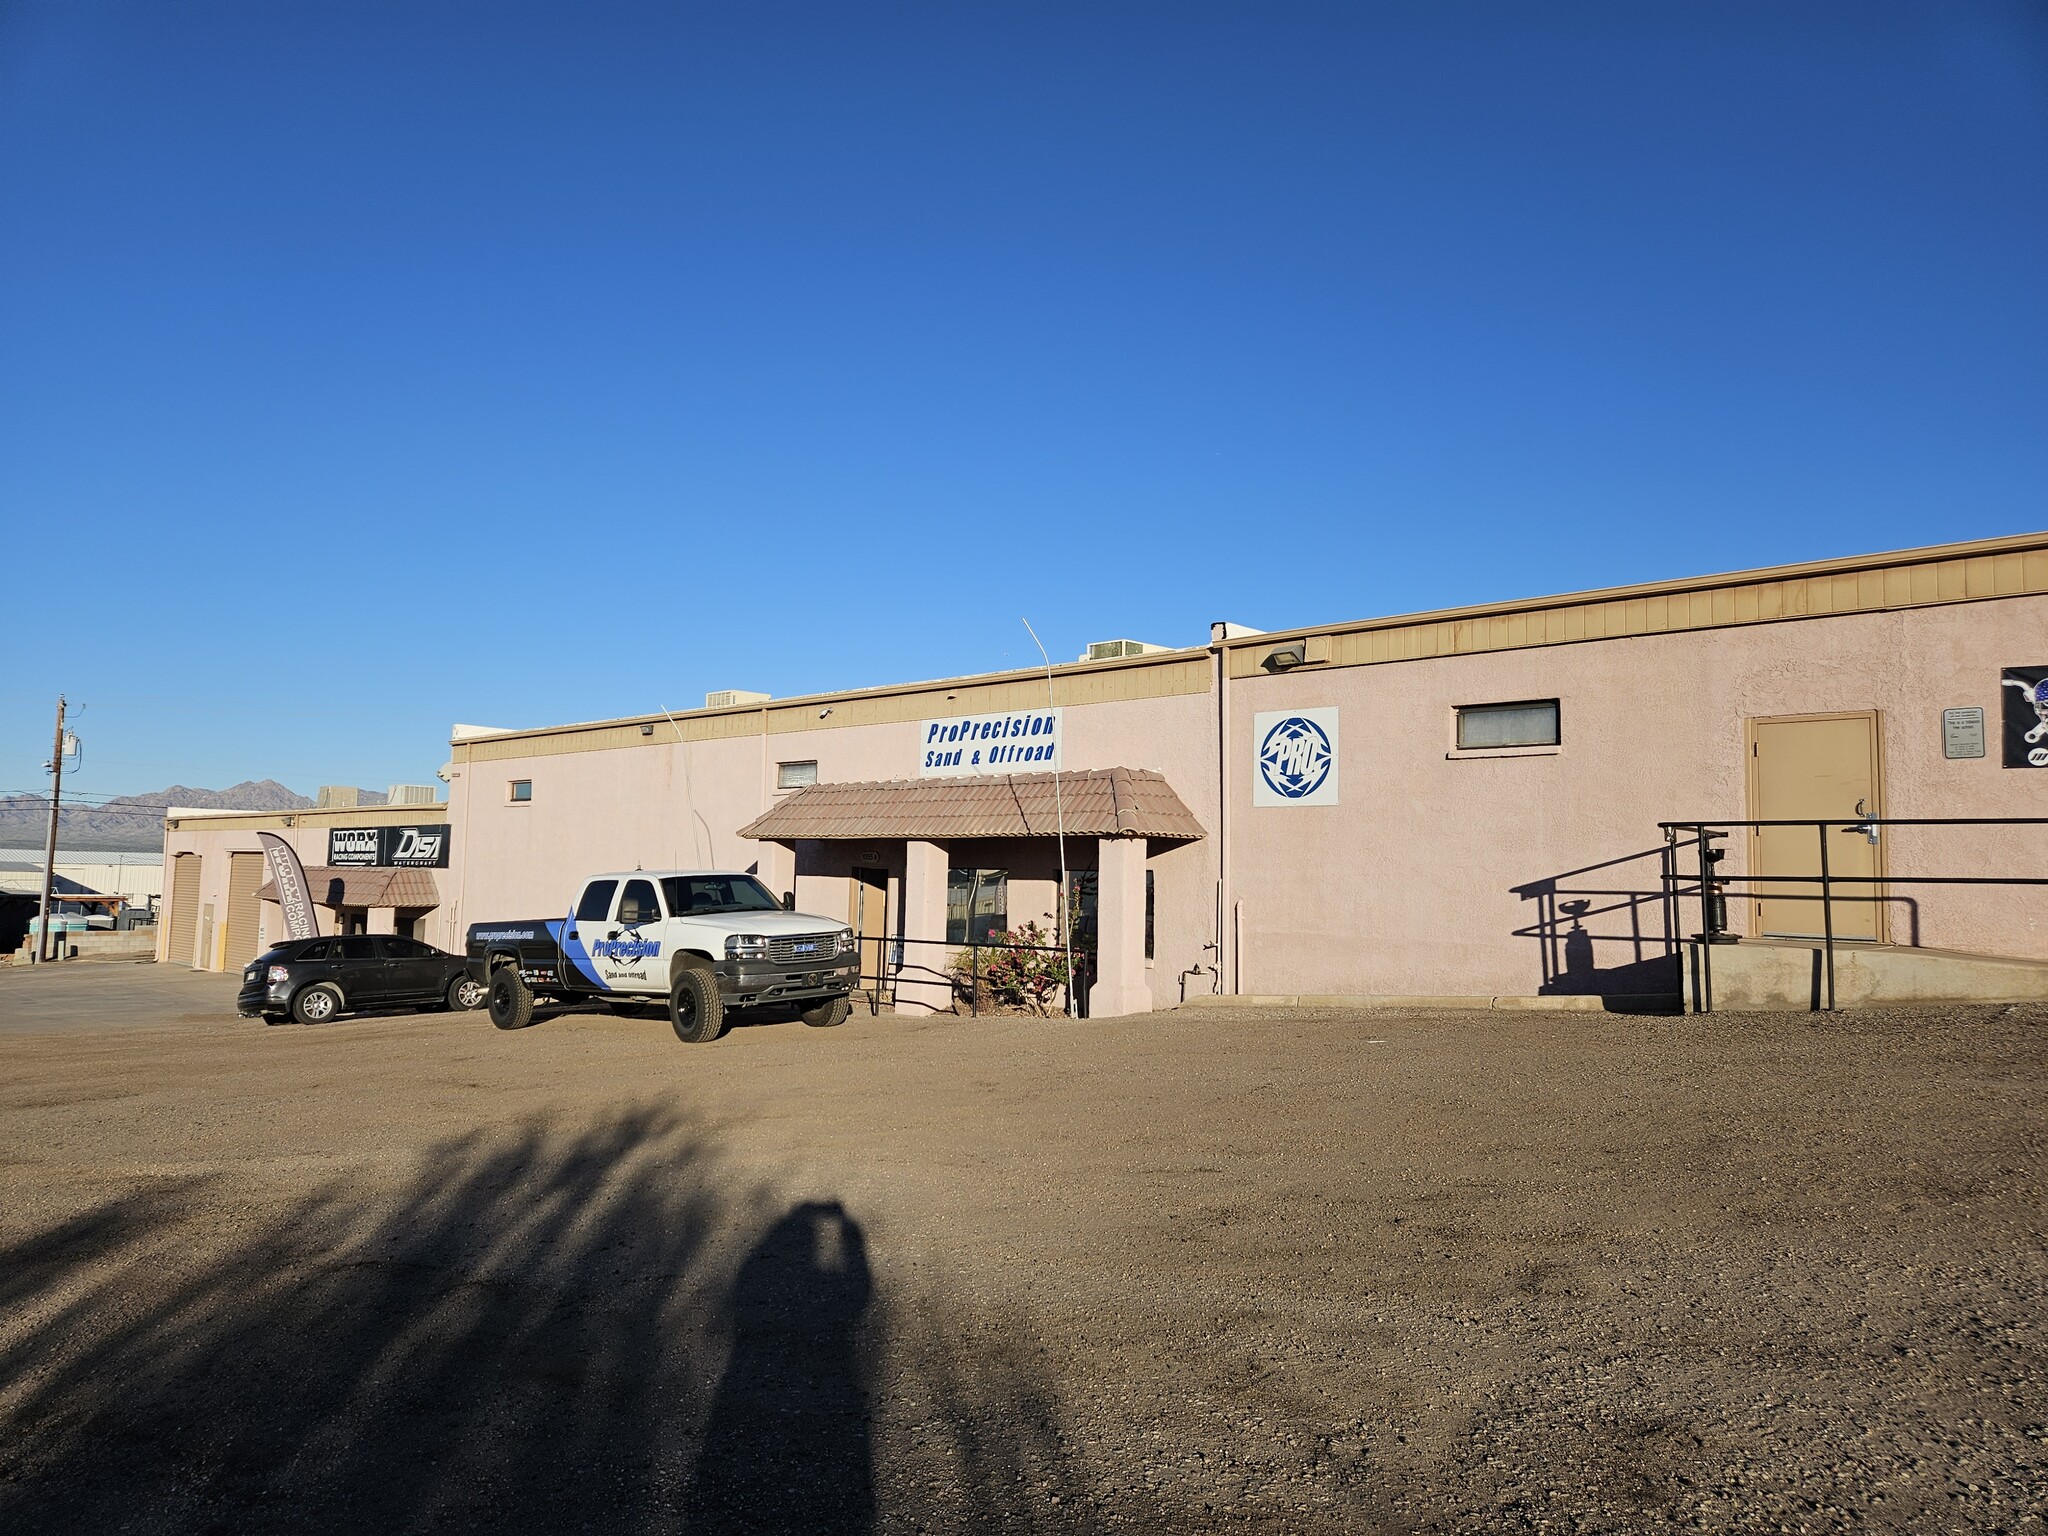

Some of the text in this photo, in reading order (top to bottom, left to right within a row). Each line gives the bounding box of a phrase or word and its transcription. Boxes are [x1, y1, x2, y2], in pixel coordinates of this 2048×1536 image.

[927, 715, 1055, 743] ProPrecision
[925, 742, 1055, 767] Sand & Offroad
[1274, 736, 1319, 776] PRO
[333, 830, 377, 852] WORX
[592, 938, 661, 957] ProPrecision
[795, 943, 817, 953] GMC
[605, 969, 617, 979] Sand
